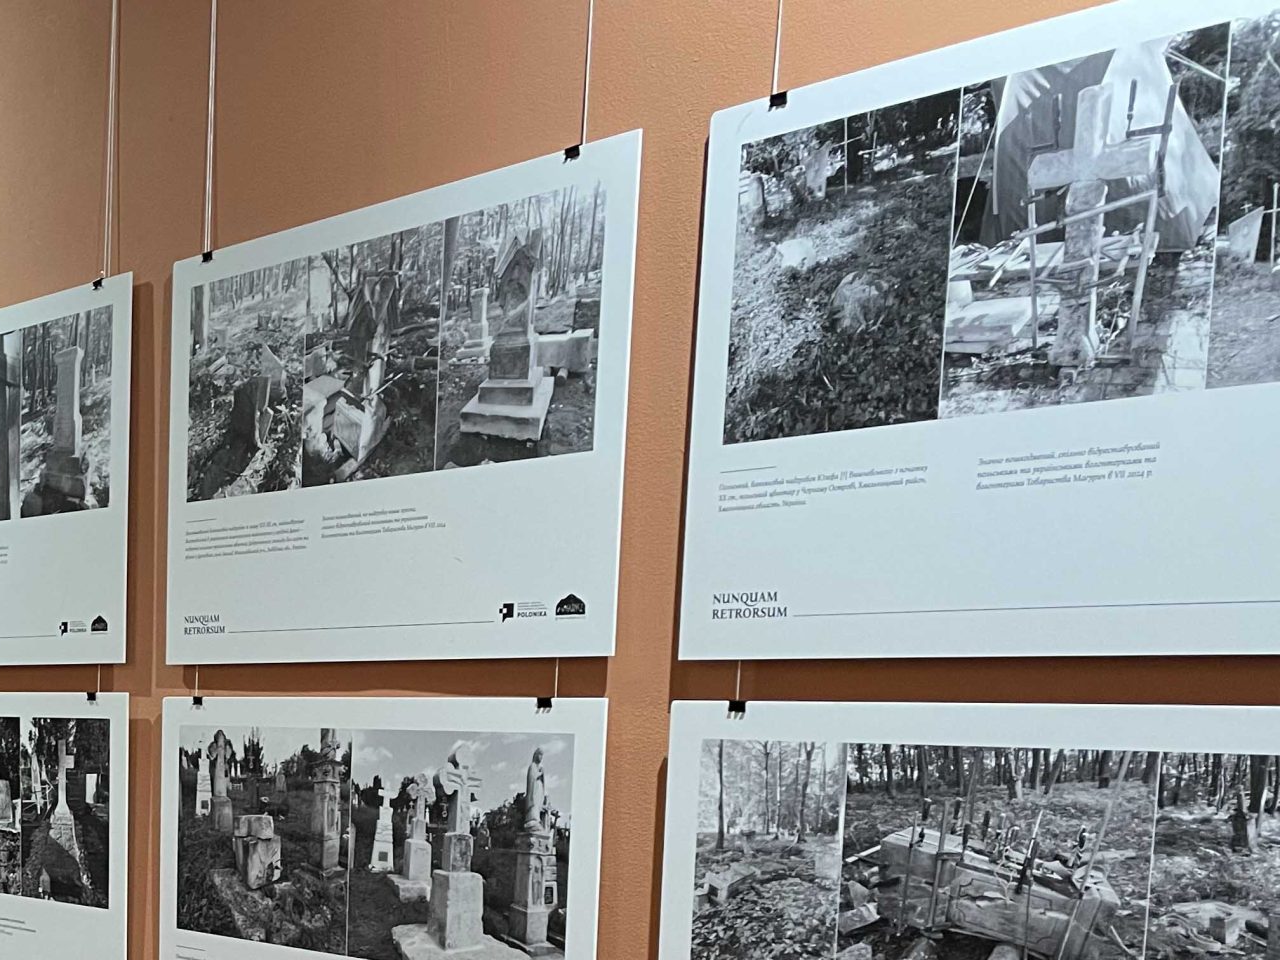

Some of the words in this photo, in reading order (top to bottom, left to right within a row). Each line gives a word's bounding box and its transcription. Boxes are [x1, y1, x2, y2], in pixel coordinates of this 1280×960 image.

[713, 591, 778, 607] NUNQUAM
[712, 606, 788, 620] RETRORSUM
[184, 614, 220, 626] NUNQUAM
[183, 625, 226, 635] RETRORSUM
